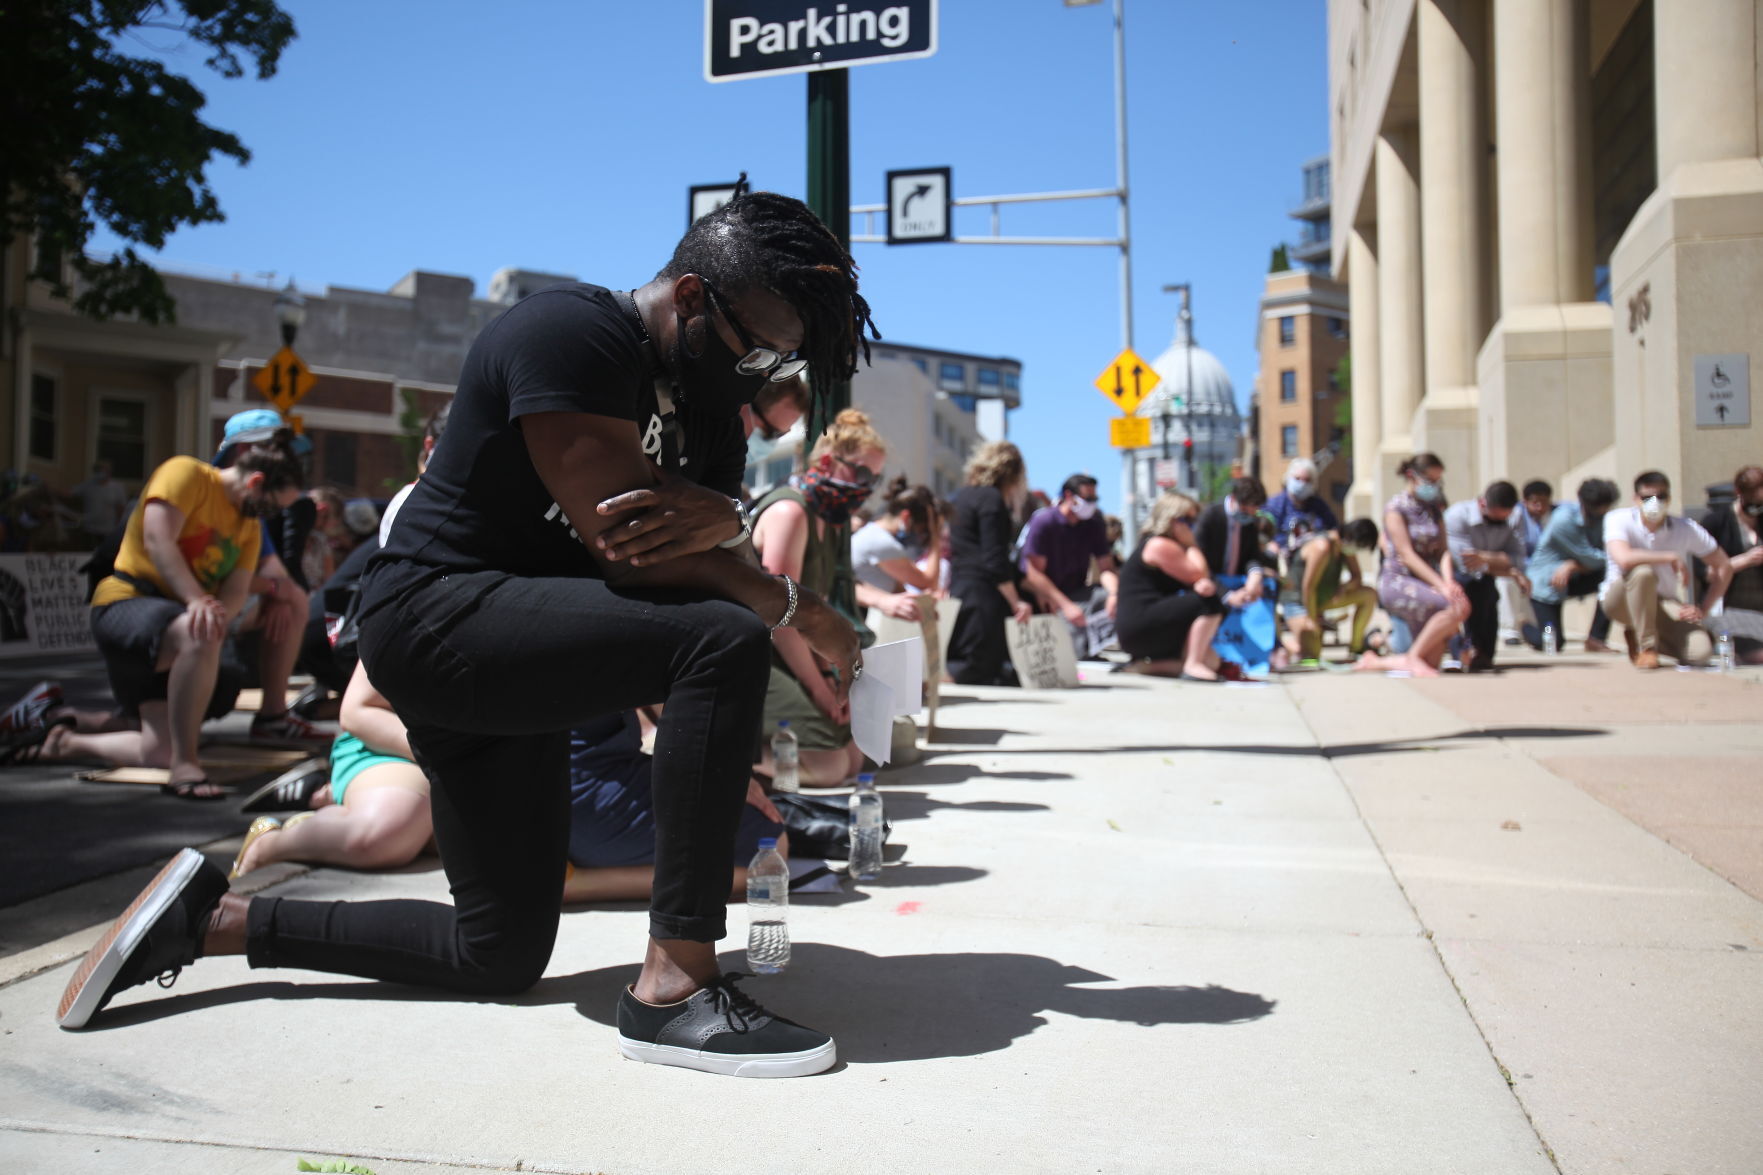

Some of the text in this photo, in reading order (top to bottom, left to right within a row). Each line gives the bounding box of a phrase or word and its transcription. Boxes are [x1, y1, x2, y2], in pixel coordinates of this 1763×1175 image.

[729, 3, 911, 58] Parking
[25, 557, 77, 574] BLACK
[28, 576, 78, 594] LIVES
